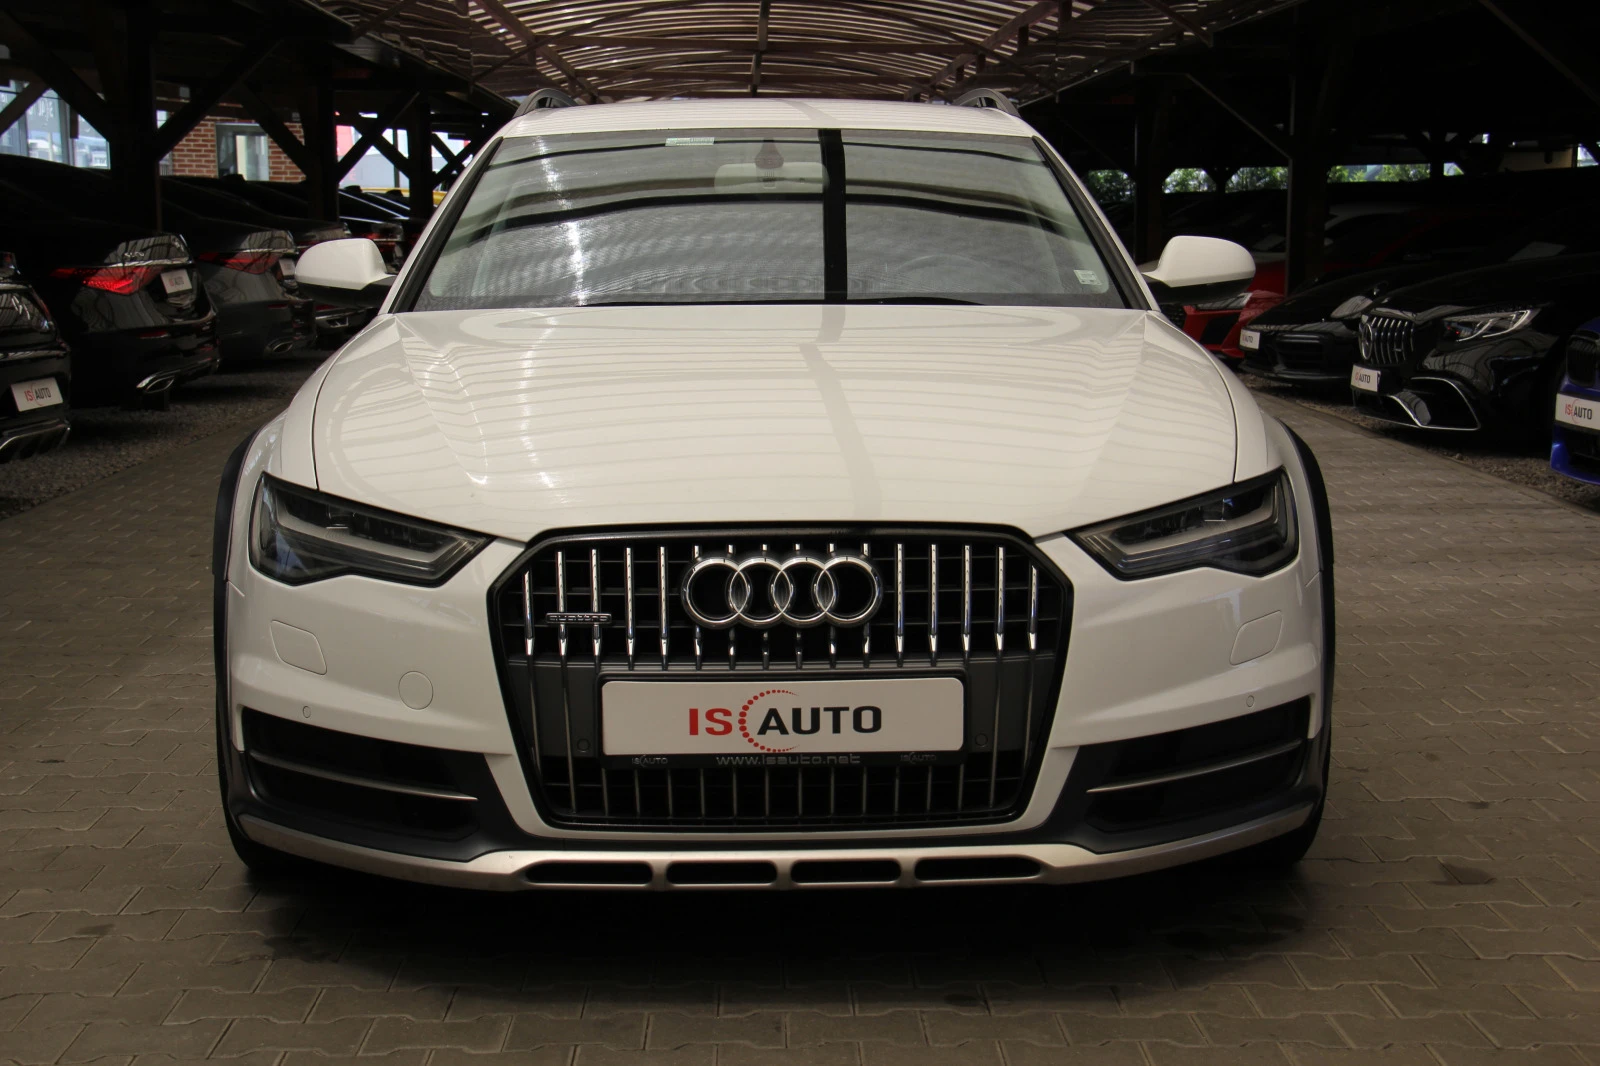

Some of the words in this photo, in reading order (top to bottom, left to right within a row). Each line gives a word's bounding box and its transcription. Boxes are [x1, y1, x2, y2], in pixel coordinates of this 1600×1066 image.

[1359, 373, 1371, 384] AUTO
[24, 390, 34, 402] IS
[34, 387, 52, 400] AUTO
[1565, 403, 1573, 416] IS
[1573, 406, 1593, 420] AUTO
[688, 708, 733, 736] IS
[757, 705, 883, 736] AUTO
[642, 757, 669, 765] AUTO
[715, 753, 862, 766] www.isauto.net
